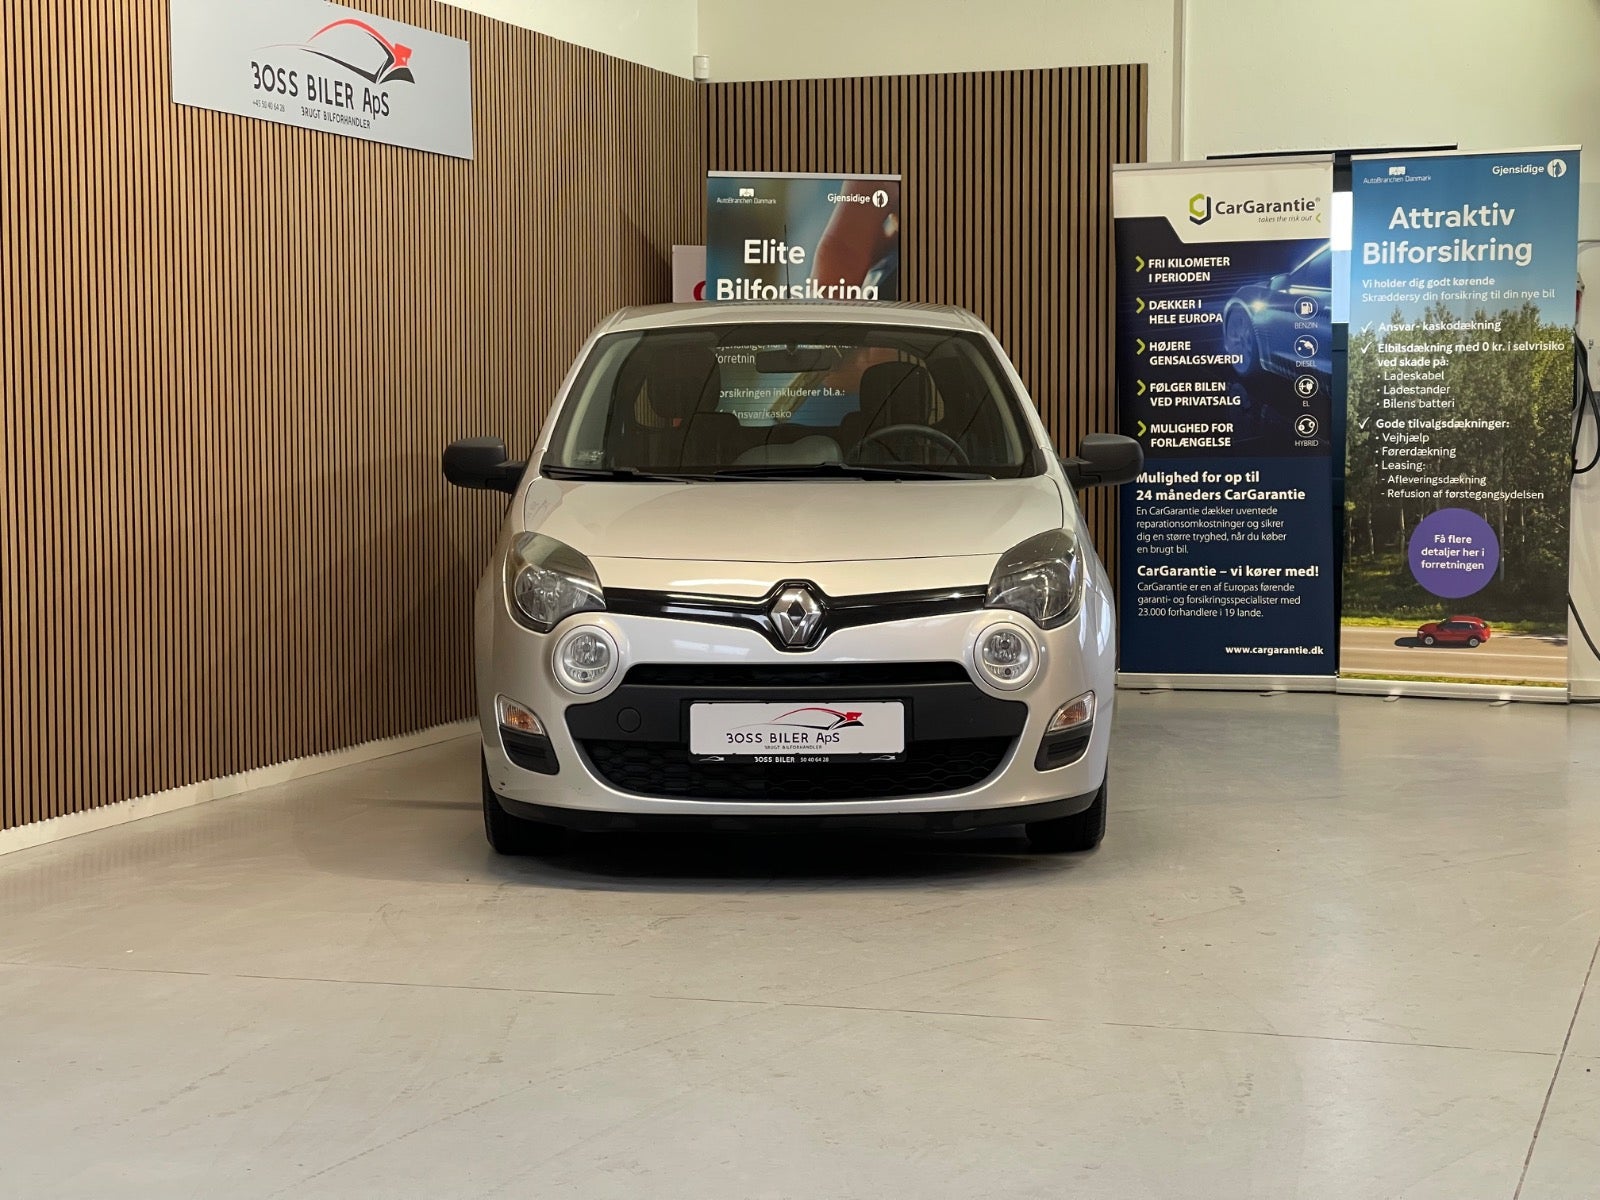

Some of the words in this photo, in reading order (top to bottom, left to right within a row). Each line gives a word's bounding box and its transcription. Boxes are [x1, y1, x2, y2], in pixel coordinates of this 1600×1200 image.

[307, 74, 354, 110] BILER
[363, 87, 390, 120] ApS
[323, 111, 371, 129] BILFORHANDLER
[1492, 165, 1544, 176] Gjensidige
[1363, 176, 1404, 184] AutoBranchen
[1405, 175, 1431, 183] Danmark
[827, 193, 870, 205] Gjensidige
[1258, 215, 1275, 223] takes
[1389, 202, 1515, 230] Attraktiv
[744, 239, 806, 264] Elite
[1363, 238, 1532, 266] Bilforsikring
[1149, 259, 1165, 268] FRI
[1168, 257, 1230, 268] KILOMETER
[1154, 272, 1210, 282] PERIODEN
[1363, 279, 1373, 288] Vi
[1374, 278, 1407, 288] holder
[1409, 278, 1425, 289] dig
[1427, 278, 1451, 289] godt
[1453, 277, 1495, 286] kørende
[1362, 293, 1420, 303] Skræddersy
[1423, 292, 1438, 301] din
[1441, 290, 1488, 301] forsikring
[1490, 290, 1500, 299] til
[1503, 290, 1519, 299] din
[1521, 291, 1540, 300] nye
[1542, 289, 1555, 298] bil
[1149, 300, 1196, 310] DÆKKER
[1149, 314, 1176, 324] HELE
[1179, 314, 1223, 323] EUROPA
[1378, 323, 1420, 332] Ansvar-
[1423, 321, 1501, 333] kaskodækning
[1149, 341, 1191, 351] HØJERE
[1378, 343, 1453, 355] Elbilsdækning
[1455, 342, 1479, 352] med
[1482, 342, 1489, 352] 0
[1492, 342, 1505, 352] kr.
[1513, 340, 1565, 351] selvrisiko
[1149, 355, 1243, 365] GENSALGSVÆRDI
[1296, 360, 1316, 368] DIESEL
[1377, 357, 1397, 367] ved
[1399, 357, 1431, 367] skade
[1433, 357, 1449, 369] på:
[1384, 371, 1444, 381] Ladeskabel
[773, 388, 820, 397] inkluderer
[1150, 382, 1192, 393] FØLGER
[1195, 382, 1226, 391] BILEN
[1383, 385, 1450, 395] Ladestander
[1150, 397, 1172, 407] VED
[1175, 396, 1241, 406] PRIVATSALG
[1383, 399, 1416, 409] Bilens
[1418, 399, 1455, 408] batteri
[1151, 424, 1209, 434] MULIGHED
[1212, 423, 1234, 433] FOR
[1376, 419, 1405, 429] Gode
[1407, 419, 1510, 430] tilvalgsdækninger:
[1151, 437, 1231, 448] FORLÆNGELSE
[1382, 433, 1429, 444] Vejhjælp
[1382, 446, 1457, 458] Førerdækning
[1381, 461, 1426, 472] Leasing:
[1136, 471, 1199, 485] Mulighed
[1202, 471, 1221, 483] for
[1224, 473, 1242, 485] op
[1245, 471, 1259, 483] til
[1388, 475, 1487, 486] Afleveringsdækning
[1136, 490, 1152, 501] 24
[1155, 489, 1221, 501] måneders
[1224, 489, 1306, 500] CarGarantie
[1388, 489, 1431, 499] Refusion
[1433, 489, 1443, 499] af
[1445, 489, 1544, 501] førstegangsydelsen
[1136, 507, 1147, 515] En
[1149, 507, 1200, 515] CarGarantie
[1201, 507, 1234, 515] dækker
[1236, 507, 1278, 515] uventede
[1136, 519, 1244, 529] reparationsomkostninger
[1247, 521, 1259, 529] og
[1261, 520, 1284, 528] sikrer
[1136, 533, 1150, 543] dig
[1166, 533, 1191, 541] større
[1192, 532, 1229, 543] tryghed,
[1231, 532, 1245, 541] når
[1247, 532, 1259, 541] du
[1261, 532, 1287, 541] køber
[1434, 534, 1446, 544] Få
[1448, 534, 1472, 544] flere
[1150, 545, 1174, 555] brugt
[1176, 545, 1189, 554] bil.
[1421, 547, 1460, 558] detaljer
[1462, 547, 1480, 557] her
[1137, 565, 1217, 577] CarGarantie
[1231, 566, 1242, 576] vi
[1246, 566, 1282, 577] kører
[1285, 566, 1319, 577] med!
[1421, 560, 1485, 572] forretningen
[1137, 583, 1187, 591] CarGarantie
[1213, 582, 1223, 591] af
[1224, 583, 1258, 593] Europas
[1260, 583, 1295, 591] førende
[1137, 596, 1171, 605] garanti-
[1173, 597, 1184, 605] og
[1186, 595, 1278, 606] forsikringsspecialister
[1280, 596, 1300, 604] med
[1138, 608, 1166, 617] 23.000
[1168, 608, 1217, 617] forhandlere
[1225, 609, 1235, 617] 19
[1237, 608, 1263, 617] lande.
[1225, 646, 1324, 656] www.cargarantie.dk
[770, 733, 808, 744] BILER
[816, 732, 840, 745] ApS
